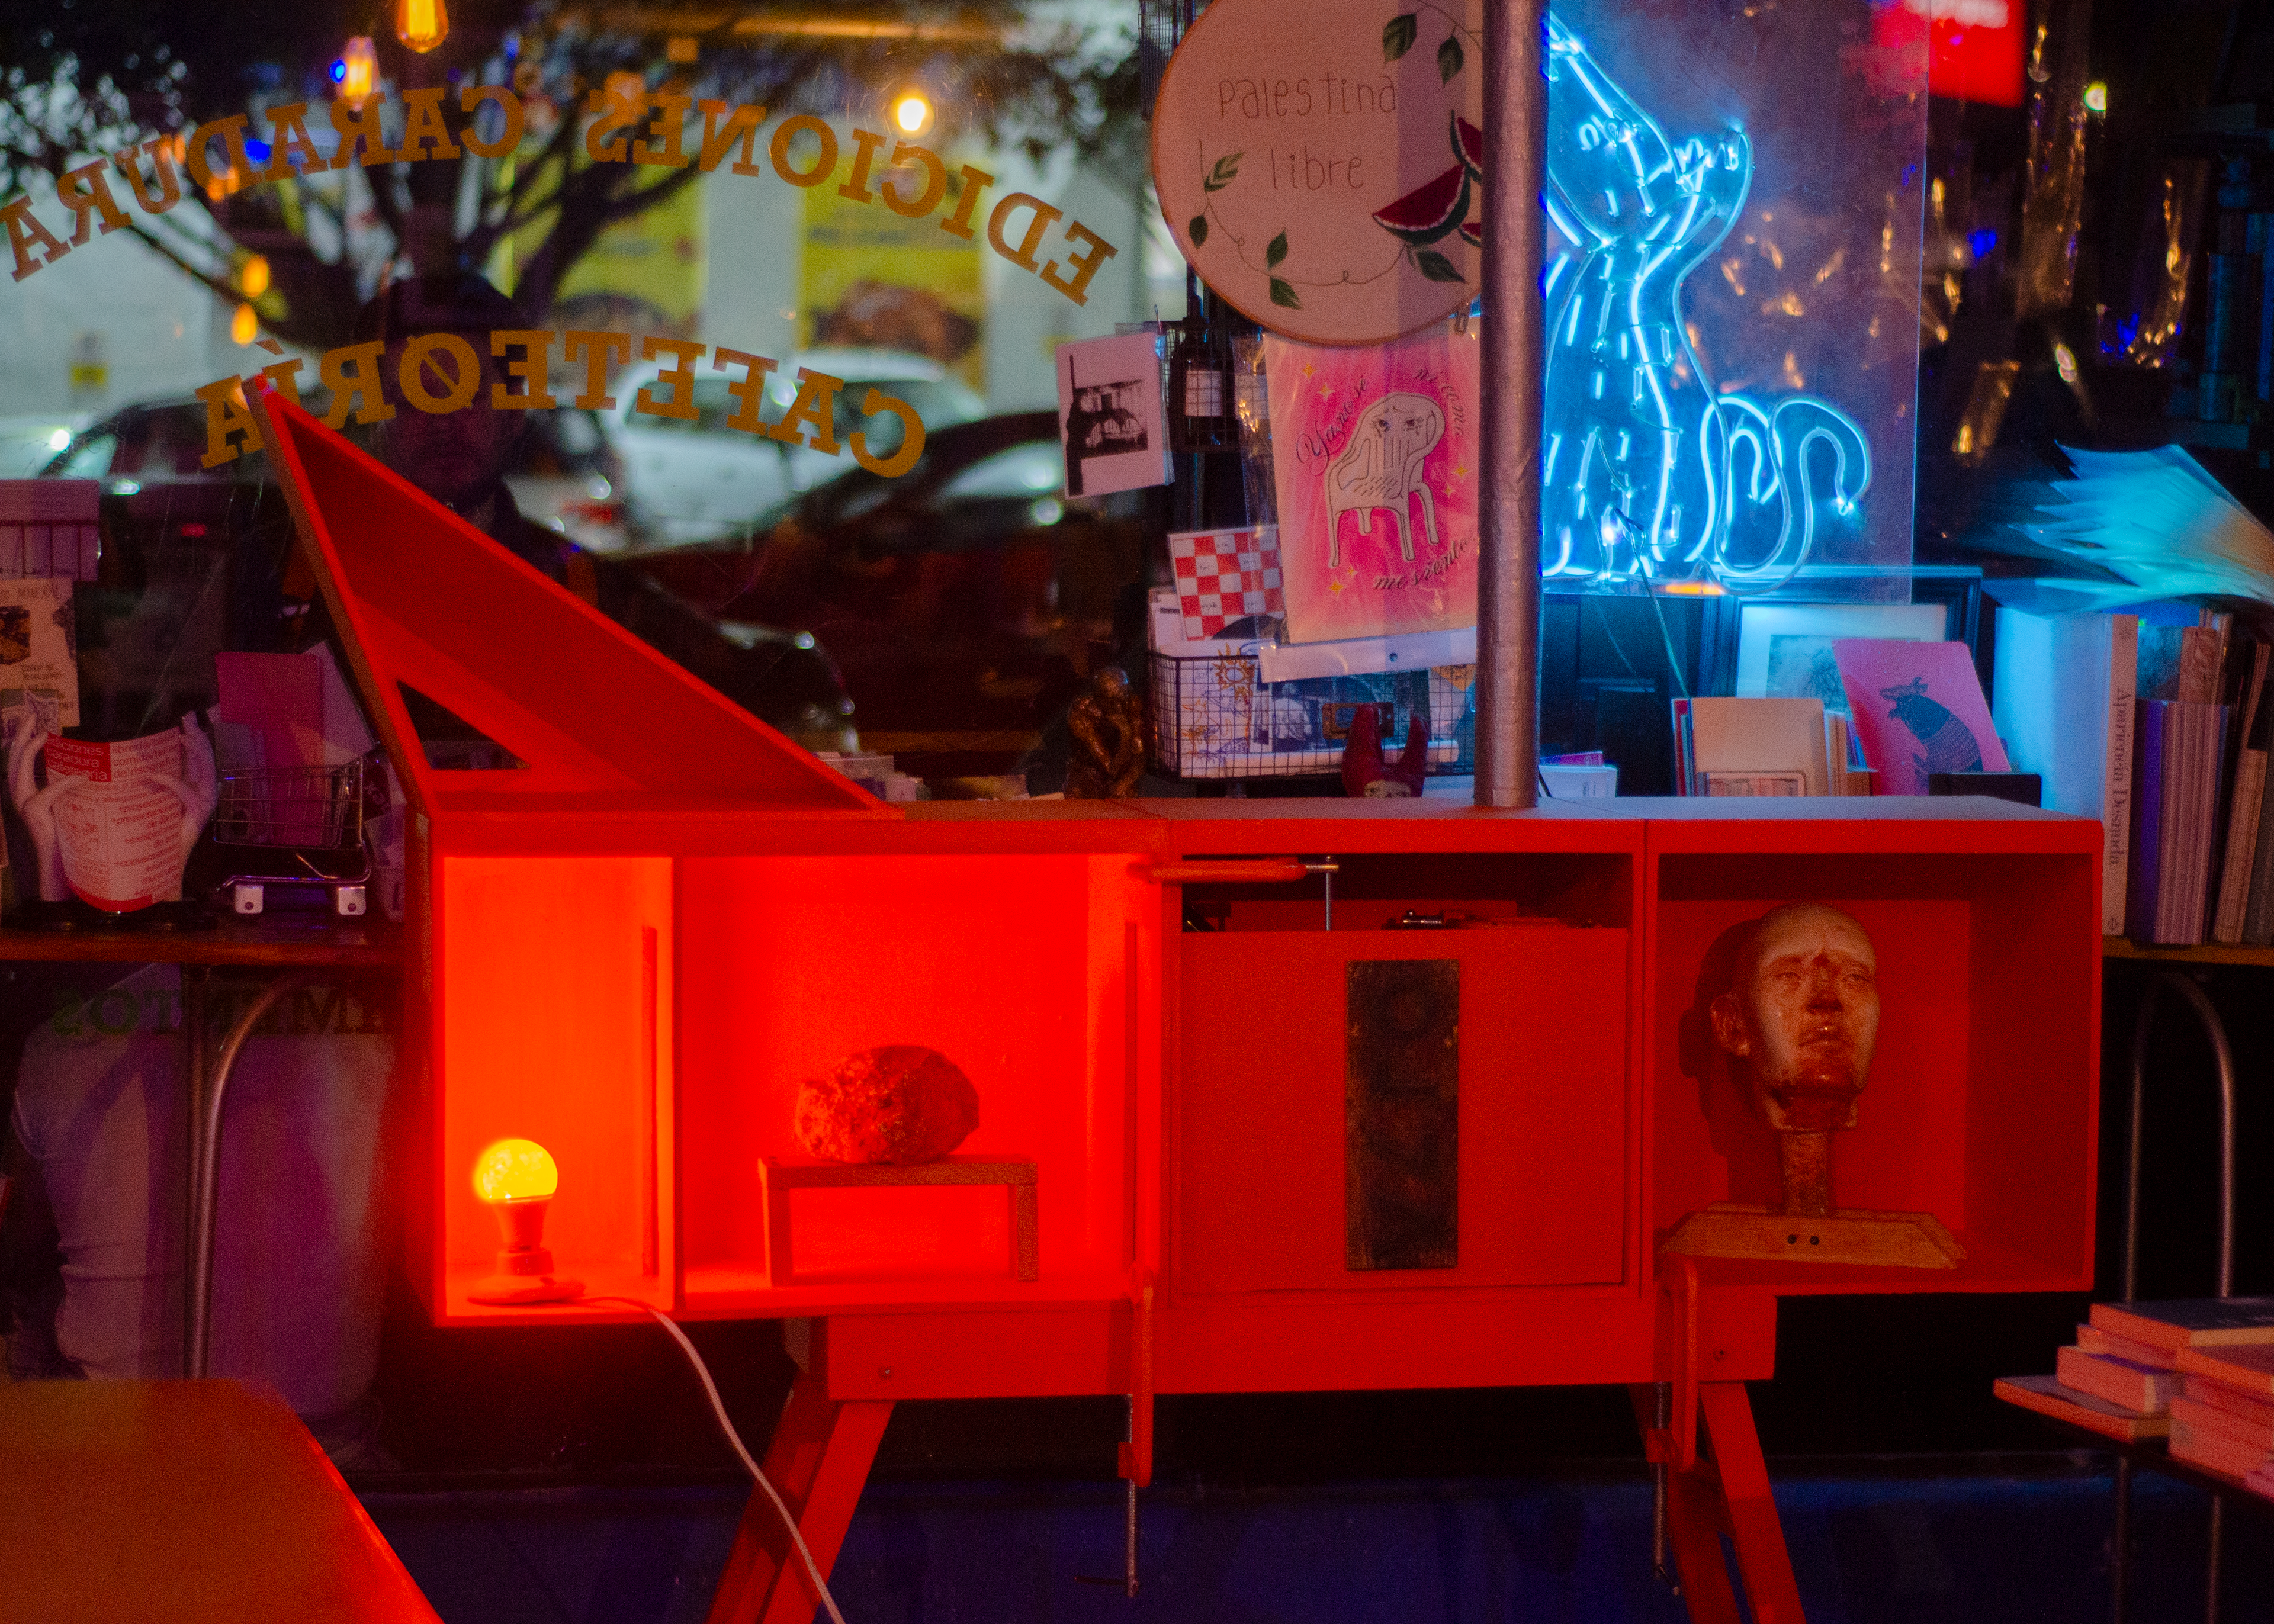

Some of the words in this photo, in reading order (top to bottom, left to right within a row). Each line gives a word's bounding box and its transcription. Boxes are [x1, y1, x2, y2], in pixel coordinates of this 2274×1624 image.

[1271, 145, 1364, 191] libre
[2113, 687, 2132, 782] Apariencia
[2109, 789, 2128, 865] Desnuda
